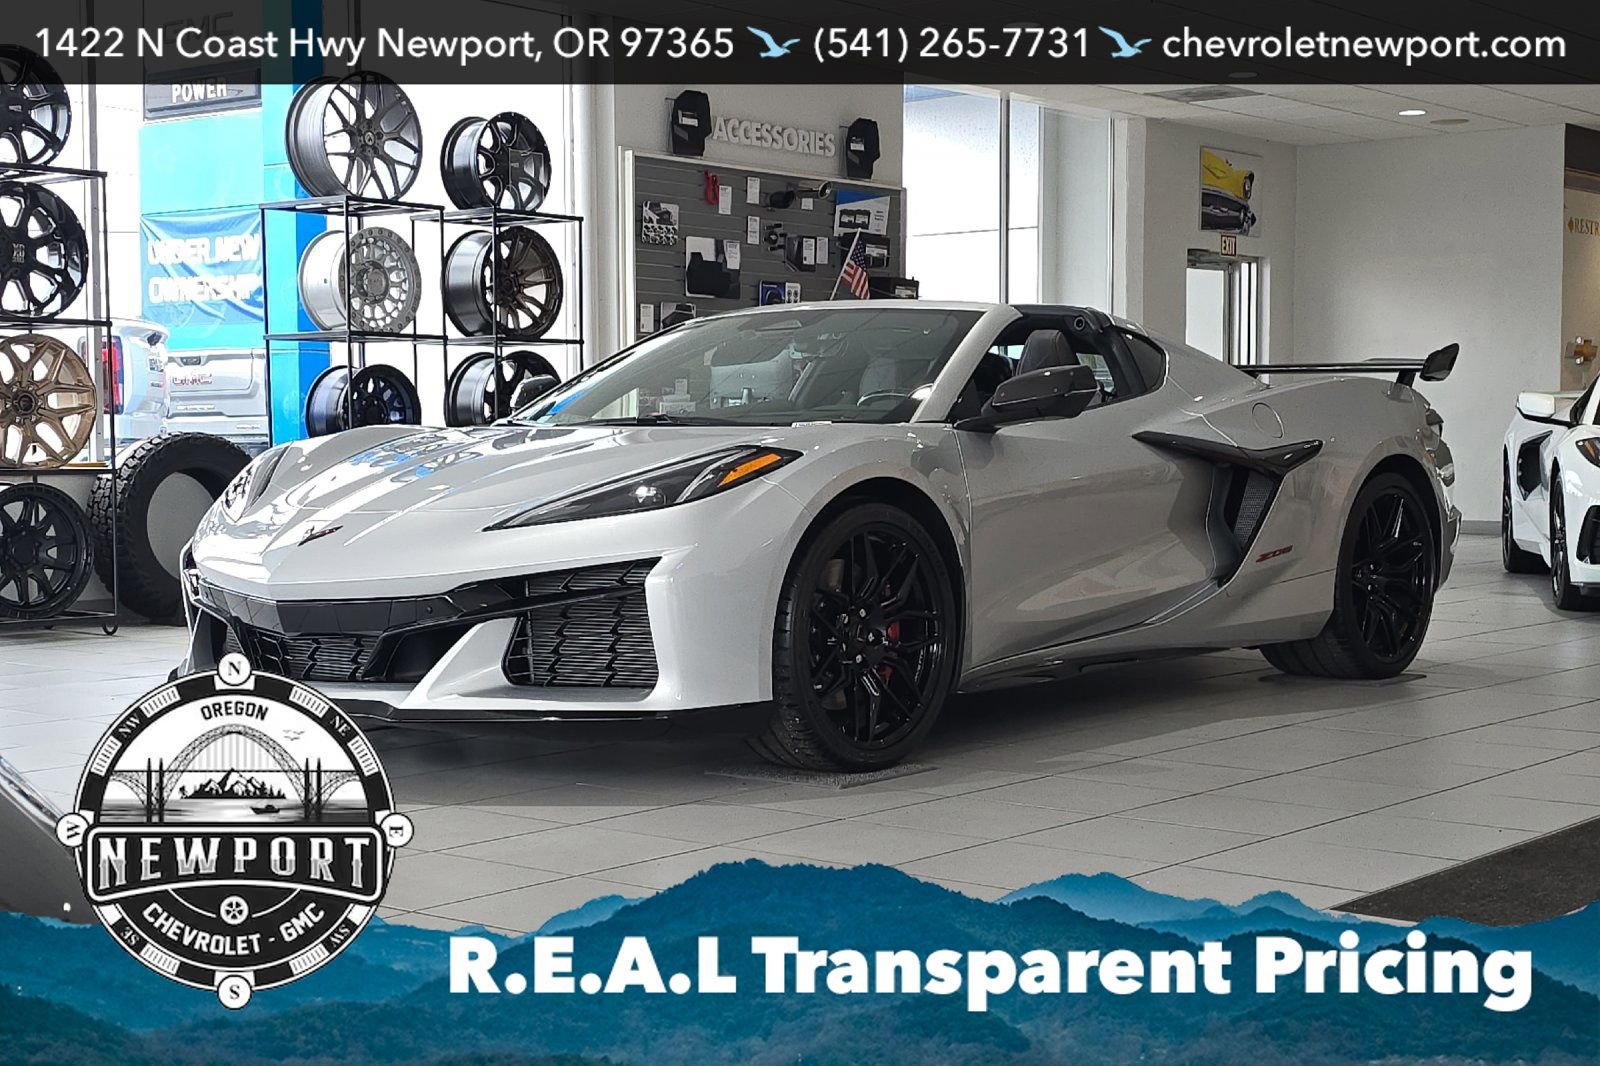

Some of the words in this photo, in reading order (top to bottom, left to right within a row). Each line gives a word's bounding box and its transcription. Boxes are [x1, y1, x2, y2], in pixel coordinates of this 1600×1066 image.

[172, 78, 227, 103] POWER
[712, 117, 836, 158] ACCESSORIES
[1221, 235, 1236, 256] EXIT
